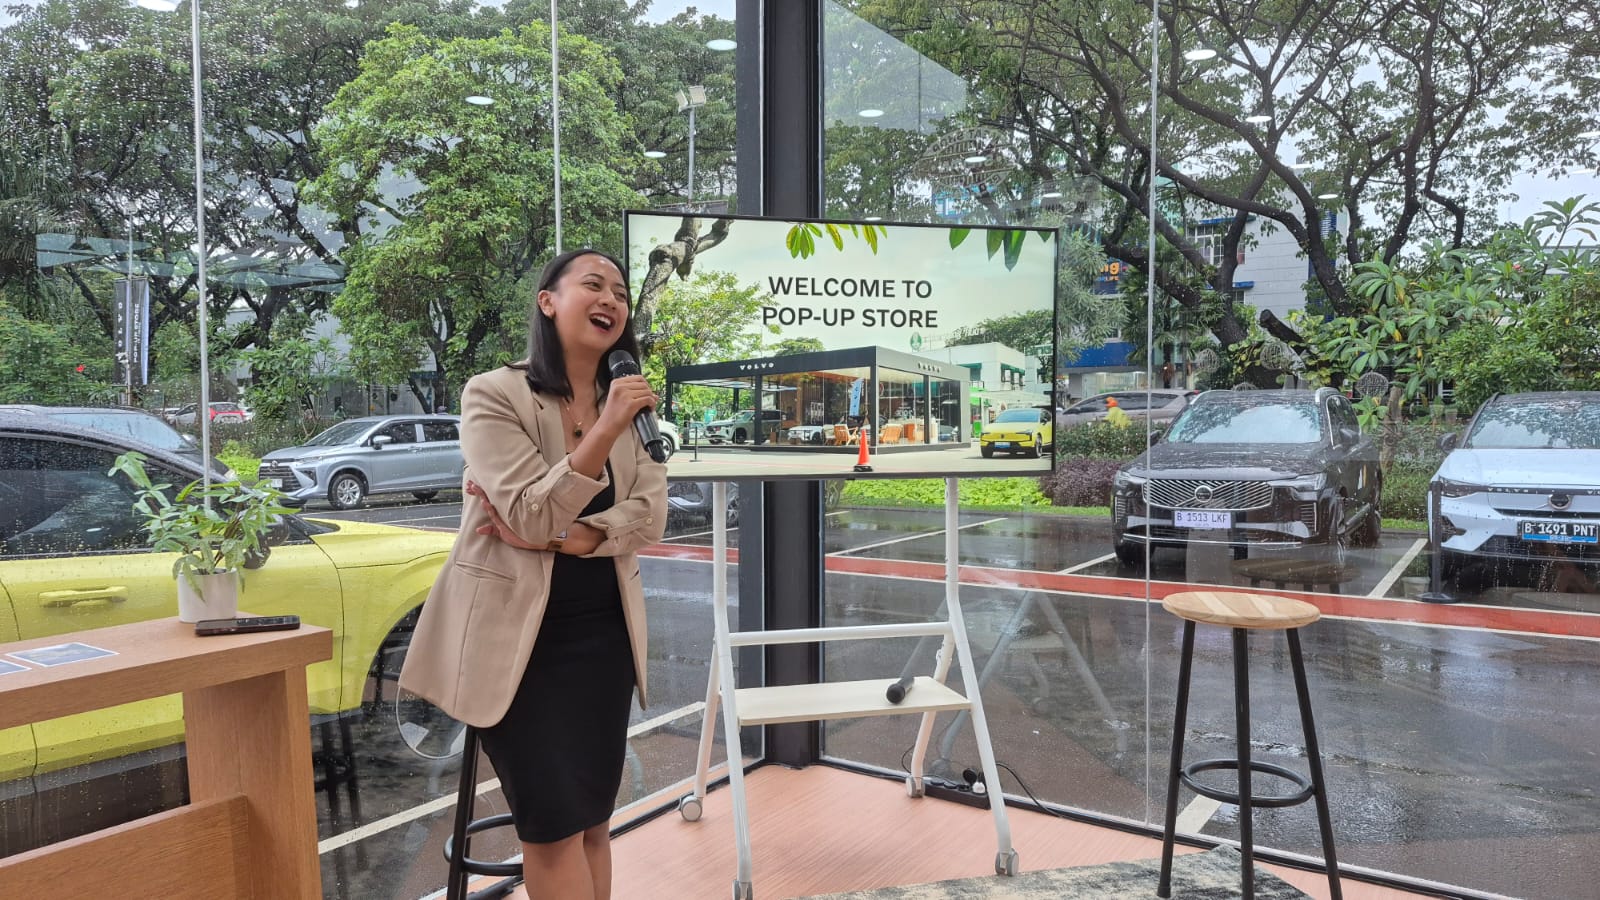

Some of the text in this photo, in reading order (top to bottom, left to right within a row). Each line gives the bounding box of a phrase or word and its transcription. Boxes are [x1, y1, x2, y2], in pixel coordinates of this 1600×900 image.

[768, 276, 932, 299] WELCOME TO
[762, 306, 938, 328] POP-UP STORE
[740, 362, 774, 370] VOLVO
[1177, 512, 1228, 523] B 1513 LKF
[1524, 522, 1532, 533] B
[1573, 524, 1595, 537] PNT
